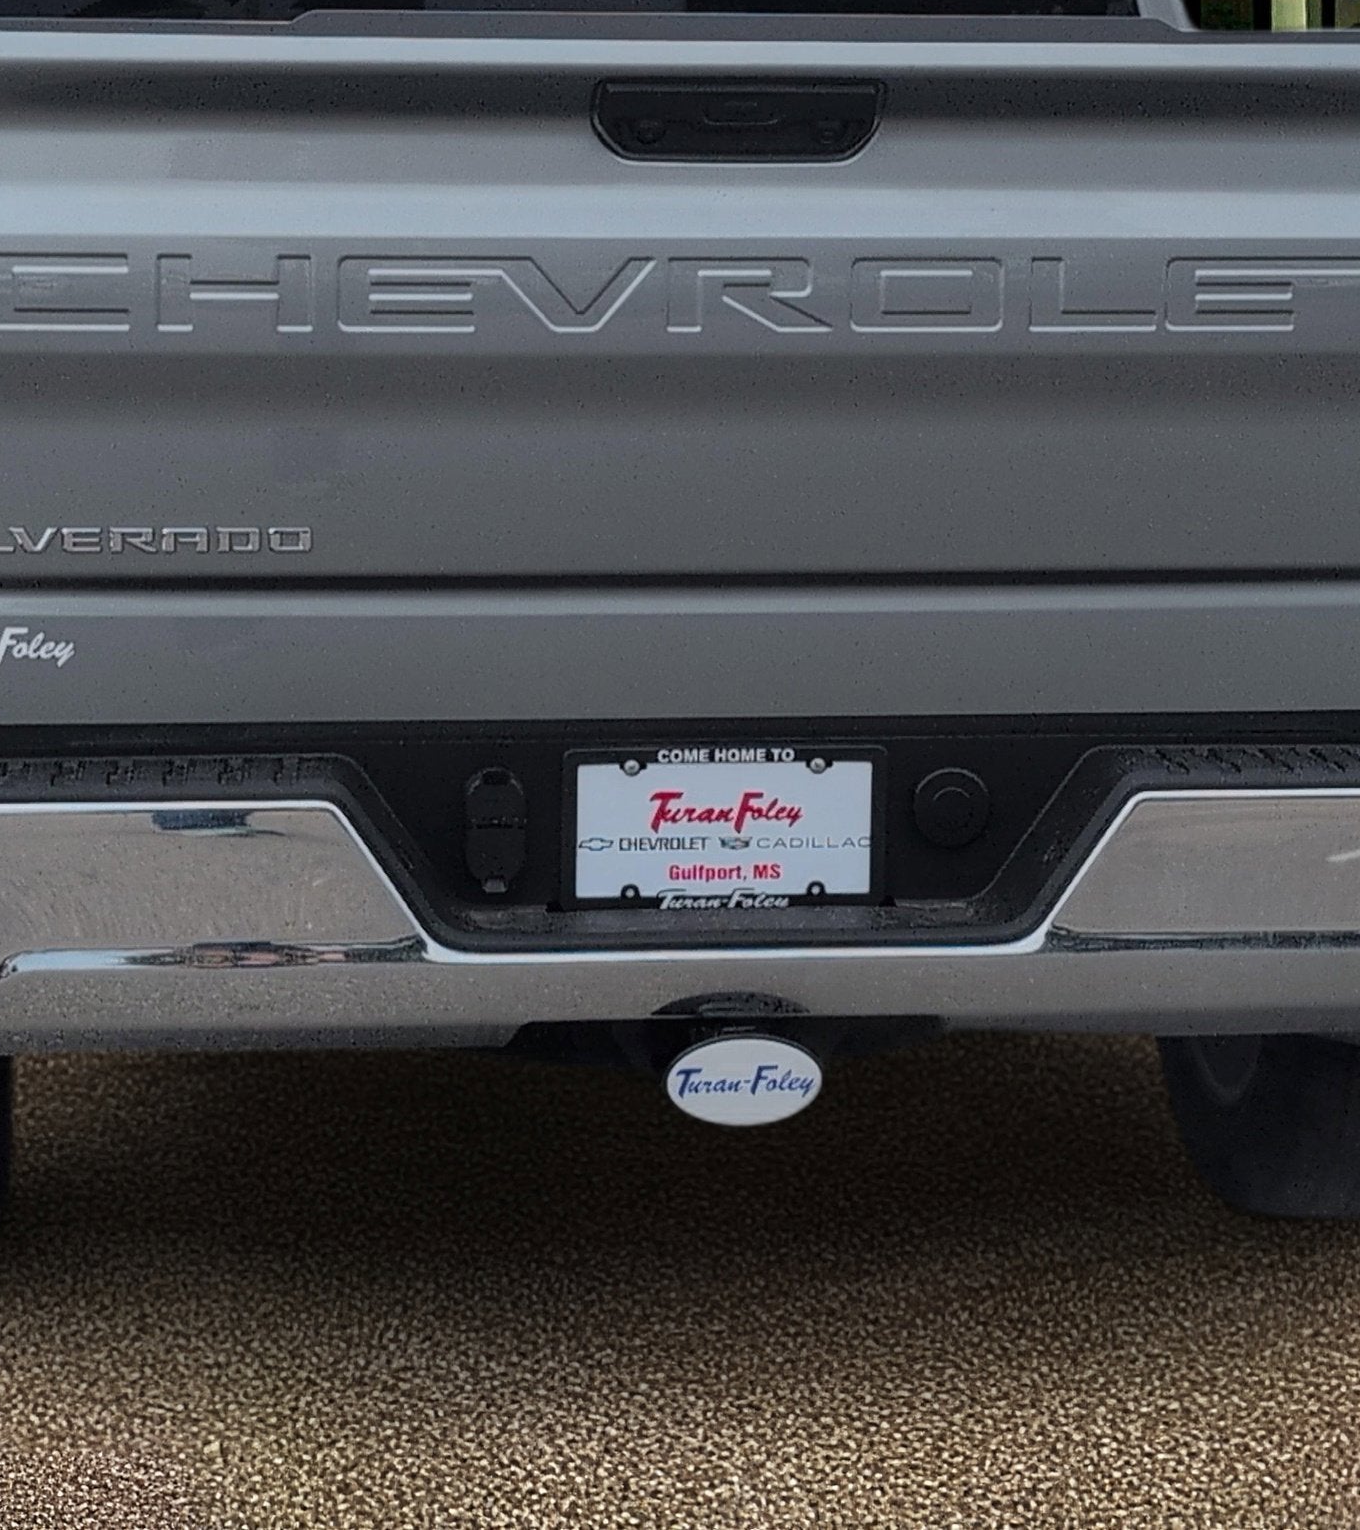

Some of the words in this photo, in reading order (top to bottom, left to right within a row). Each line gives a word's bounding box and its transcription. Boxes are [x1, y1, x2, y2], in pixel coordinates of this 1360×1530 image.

[657, 748, 709, 763] COME
[714, 747, 766, 763] HOME
[770, 747, 795, 762] TO
[618, 836, 708, 852] CHEVROLET
[756, 835, 872, 850] CADILLAC
[669, 863, 748, 883] Gulfport,
[753, 863, 781, 880] MS
